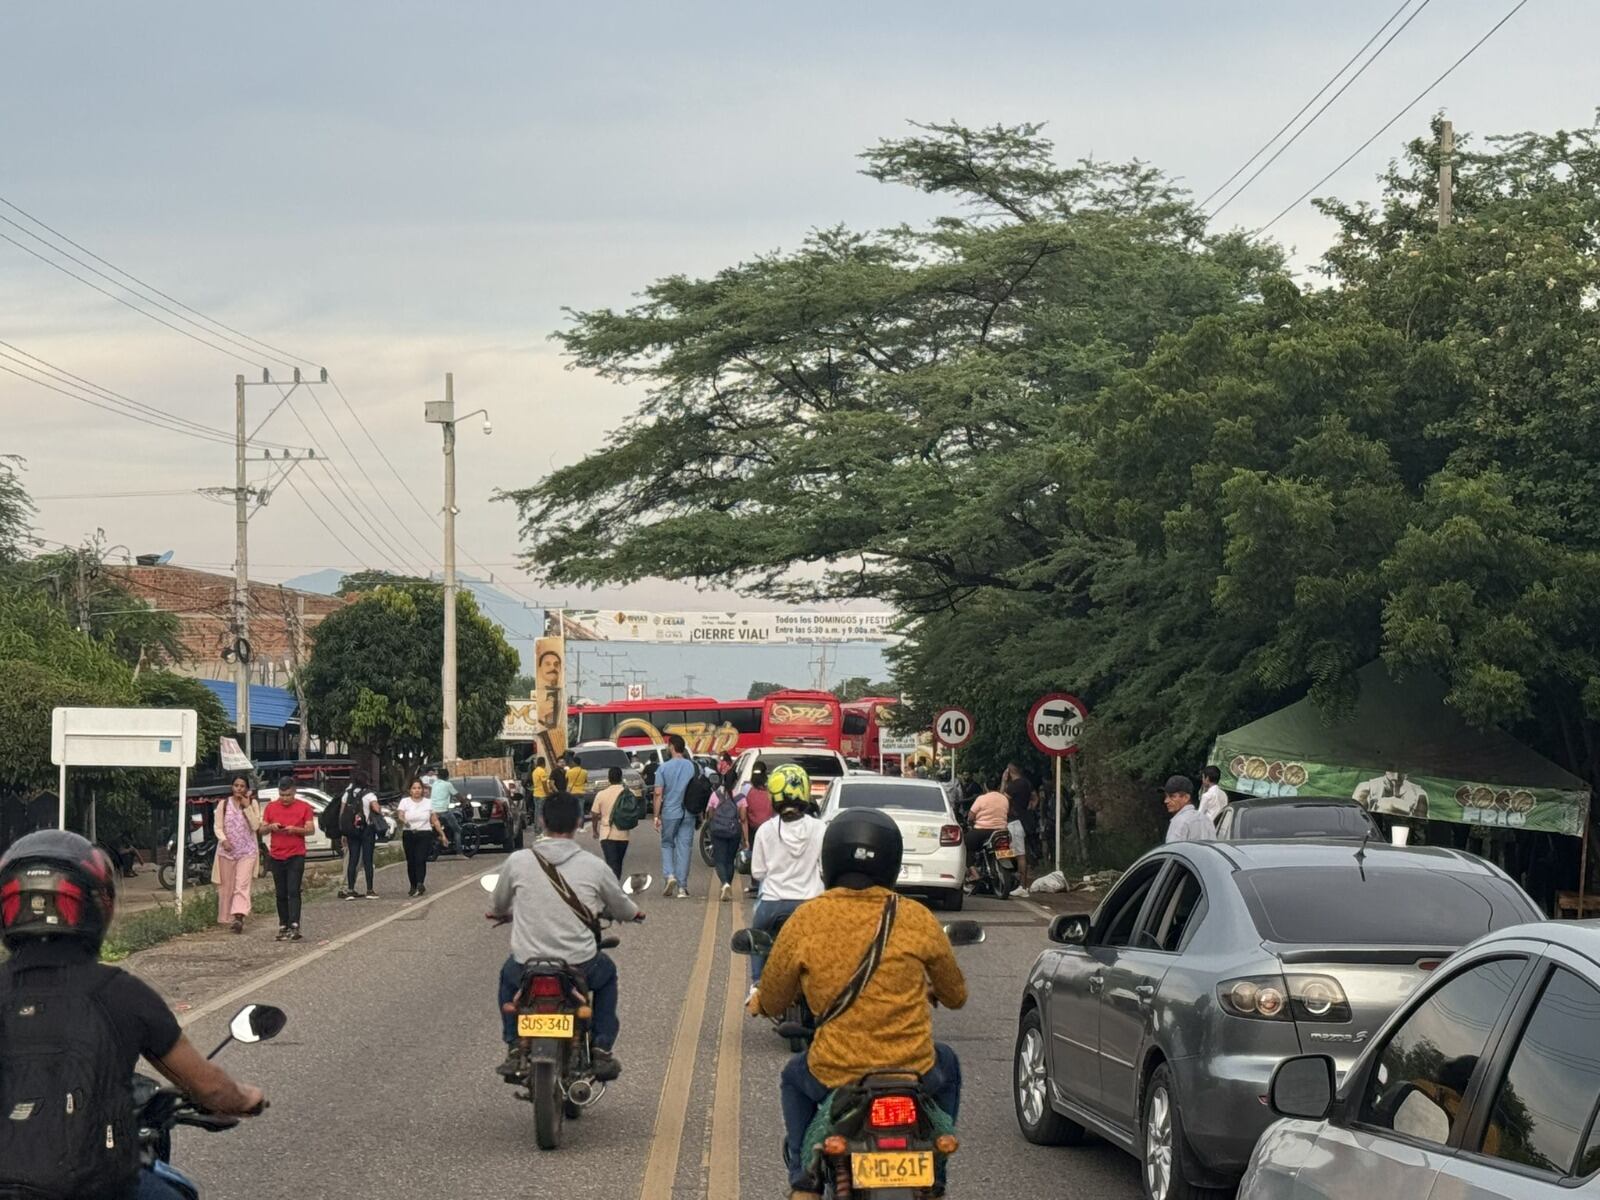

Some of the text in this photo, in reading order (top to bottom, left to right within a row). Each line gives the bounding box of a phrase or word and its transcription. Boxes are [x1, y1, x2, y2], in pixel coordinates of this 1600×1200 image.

[775, 615, 798, 624] Todos
[800, 615, 812, 624] los
[814, 616, 857, 624] DOMINGOS
[859, 617, 864, 625] y
[690, 628, 735, 642] ¡CIERRE
[739, 628, 769, 640] VIAL!
[775, 626, 794, 634] Entre
[795, 626, 806, 634] las
[941, 718, 966, 737] 40
[1037, 723, 1080, 738] DESVIO
[521, 1018, 543, 1030] SUS
[896, 1157, 929, 1177] 61F
